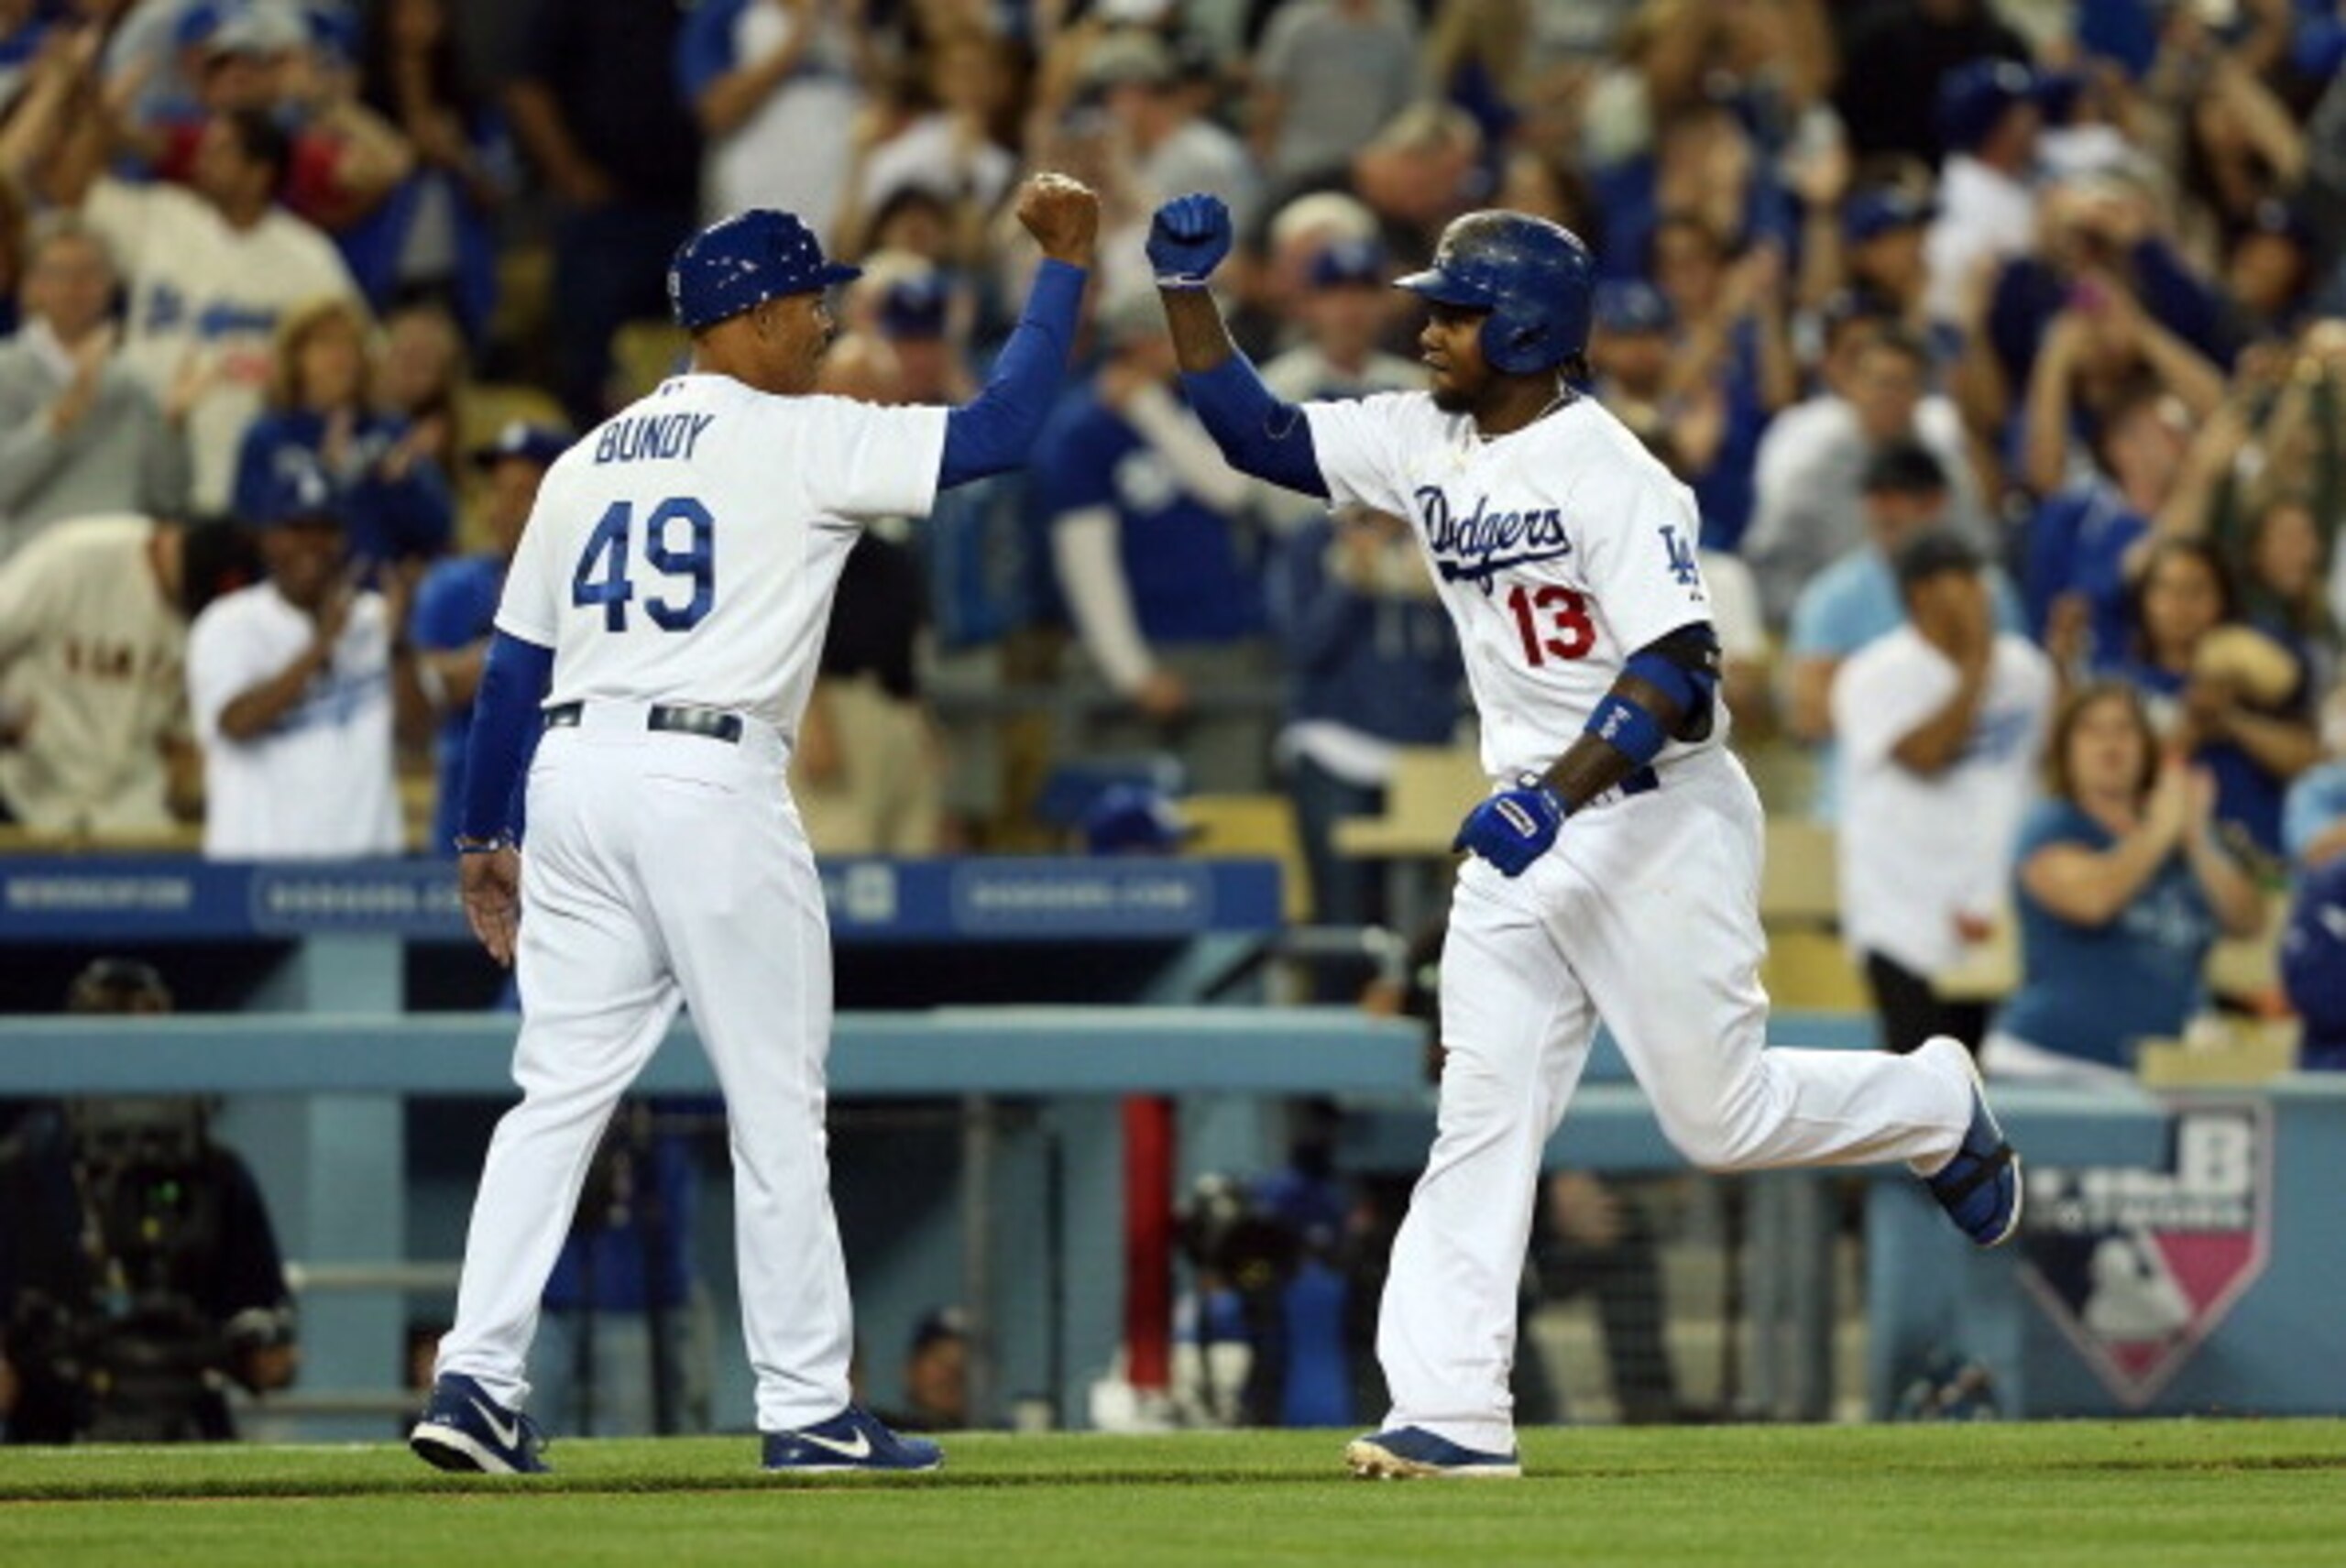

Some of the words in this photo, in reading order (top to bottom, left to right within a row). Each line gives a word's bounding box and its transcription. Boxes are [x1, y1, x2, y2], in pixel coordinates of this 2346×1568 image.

[595, 413, 715, 464] BUNDY
[573, 496, 716, 632] 49
[1414, 485, 1572, 597] Dodgers
[1508, 584, 1596, 668] 13
